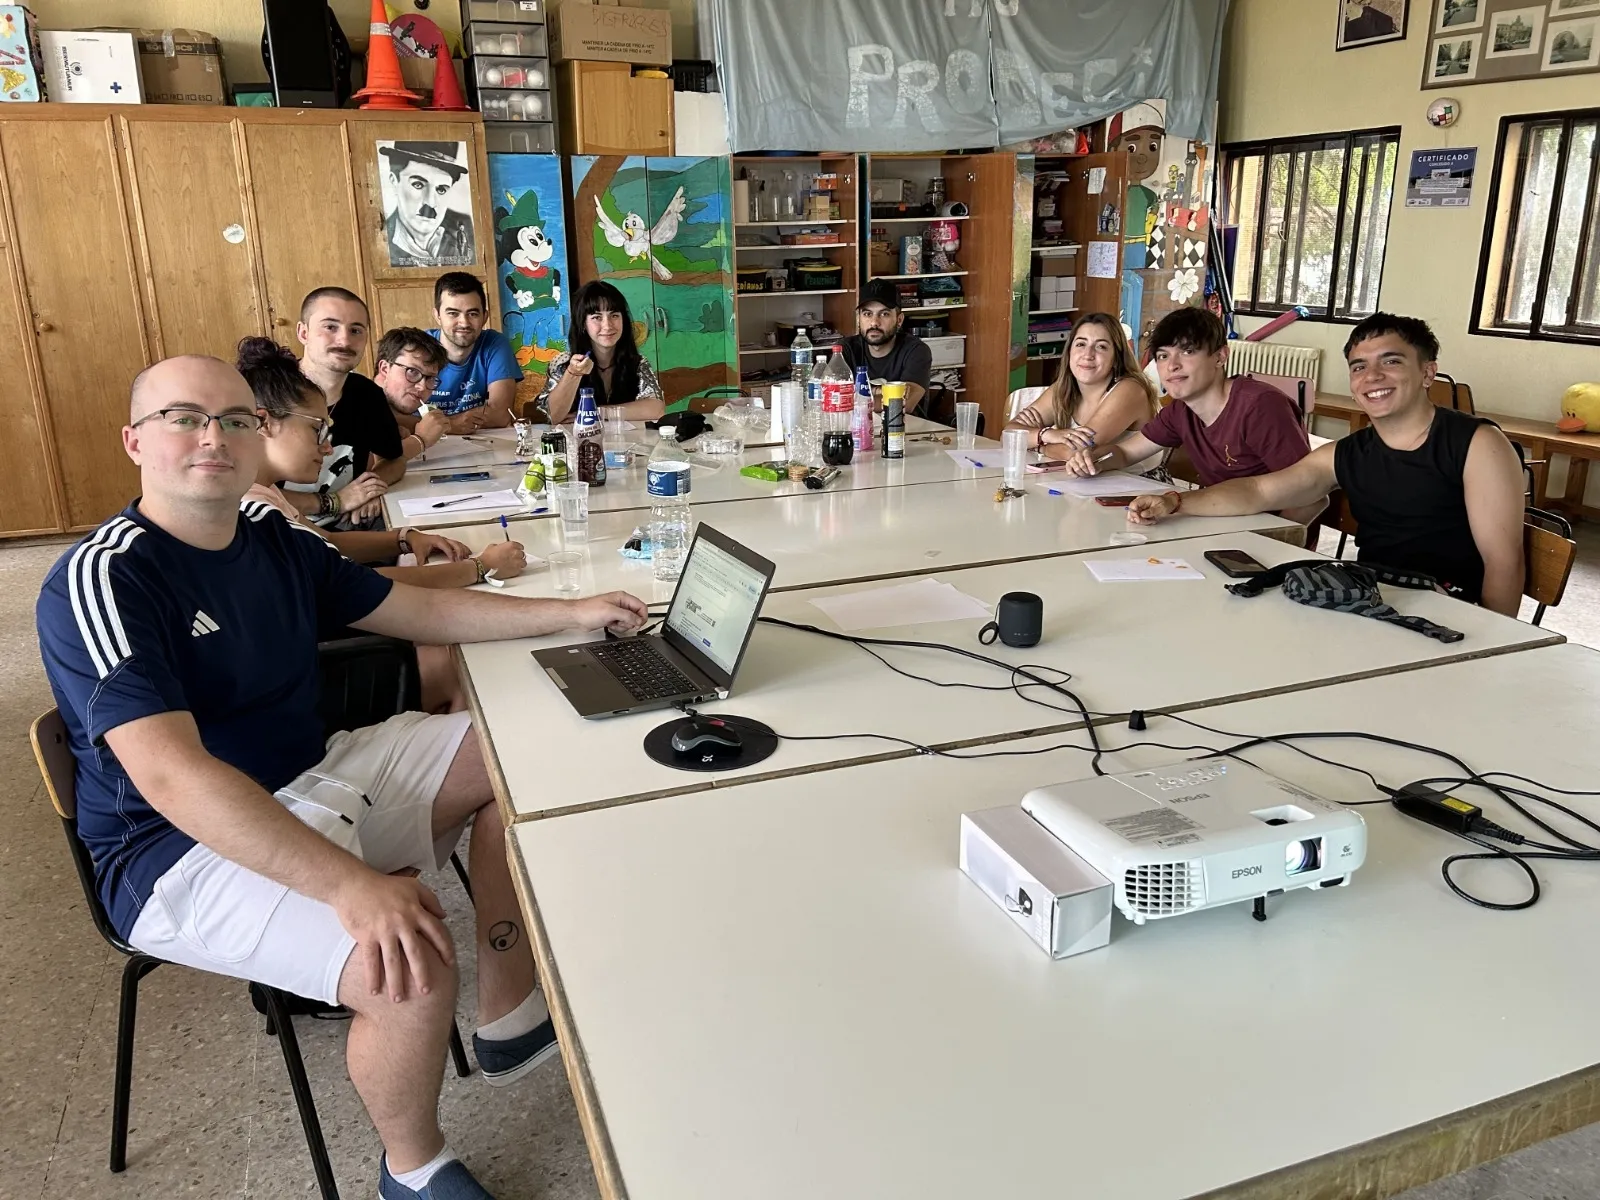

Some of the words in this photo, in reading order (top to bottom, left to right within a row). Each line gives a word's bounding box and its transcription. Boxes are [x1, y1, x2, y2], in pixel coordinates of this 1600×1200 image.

[1417, 153, 1469, 163] CERTIFICADO
[1169, 793, 1211, 804] EPSON
[1231, 864, 1263, 879] EPSON
